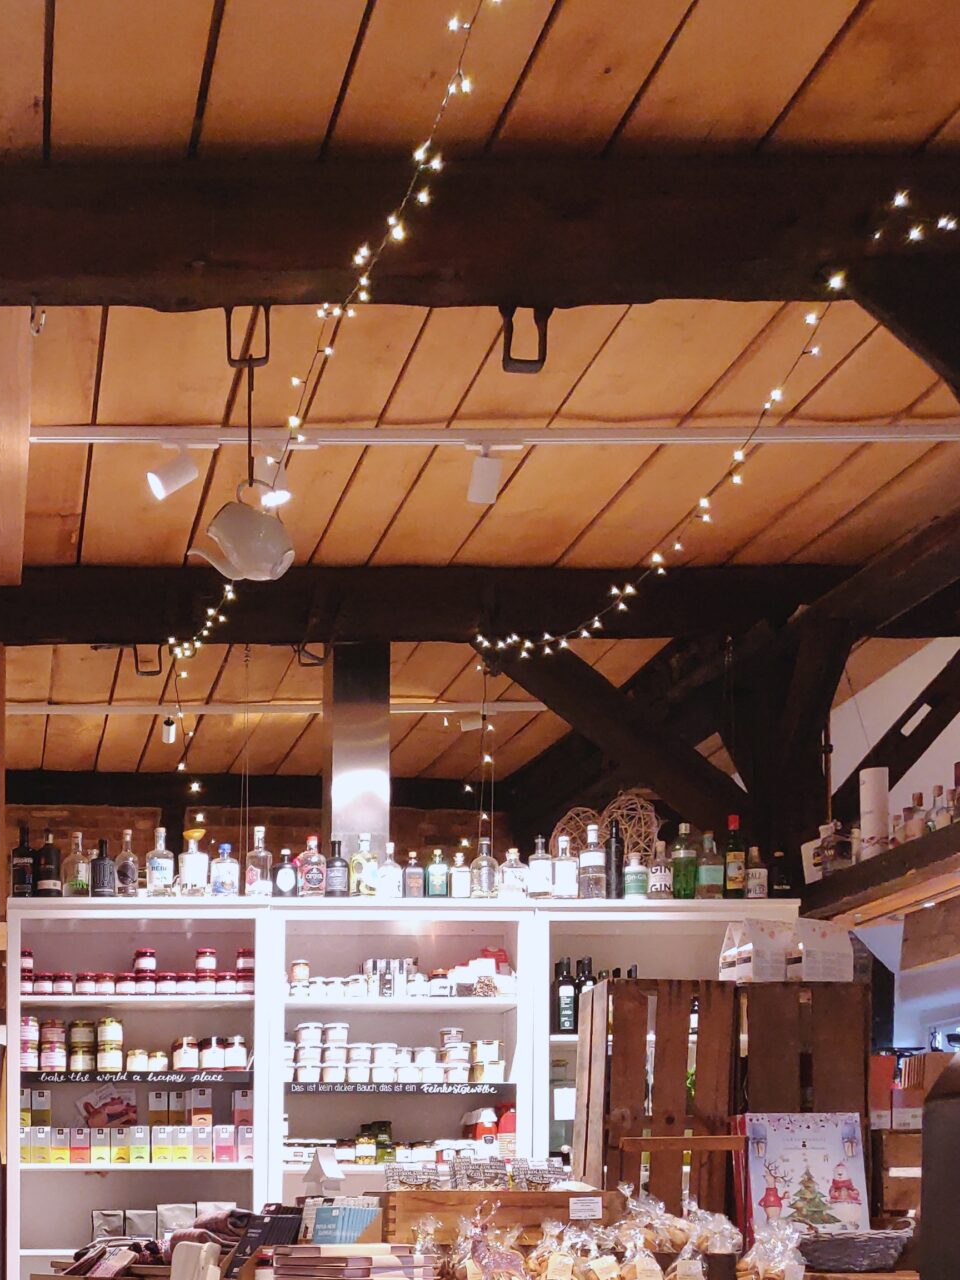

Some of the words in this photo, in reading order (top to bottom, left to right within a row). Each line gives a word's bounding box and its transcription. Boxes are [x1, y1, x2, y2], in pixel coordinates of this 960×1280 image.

[650, 864, 671, 874] GIN
[650, 884, 671, 892] GIN
[39, 1072, 66, 1083] bake
[68, 1072, 90, 1083] the
[96, 1071, 128, 1082] world
[132, 1073, 142, 1082] a
[147, 1072, 186, 1083] happy
[191, 1071, 224, 1083] place
[291, 1083, 305, 1092] Das
[306, 1083, 316, 1092] ist
[318, 1083, 333, 1092] kein
[334, 1083, 355, 1092] dicker
[379, 1083, 392, 1092] das
[394, 1084, 403, 1092] ist
[405, 1084, 417, 1092] ein
[421, 1083, 498, 1095] Feinkostgewölbe
